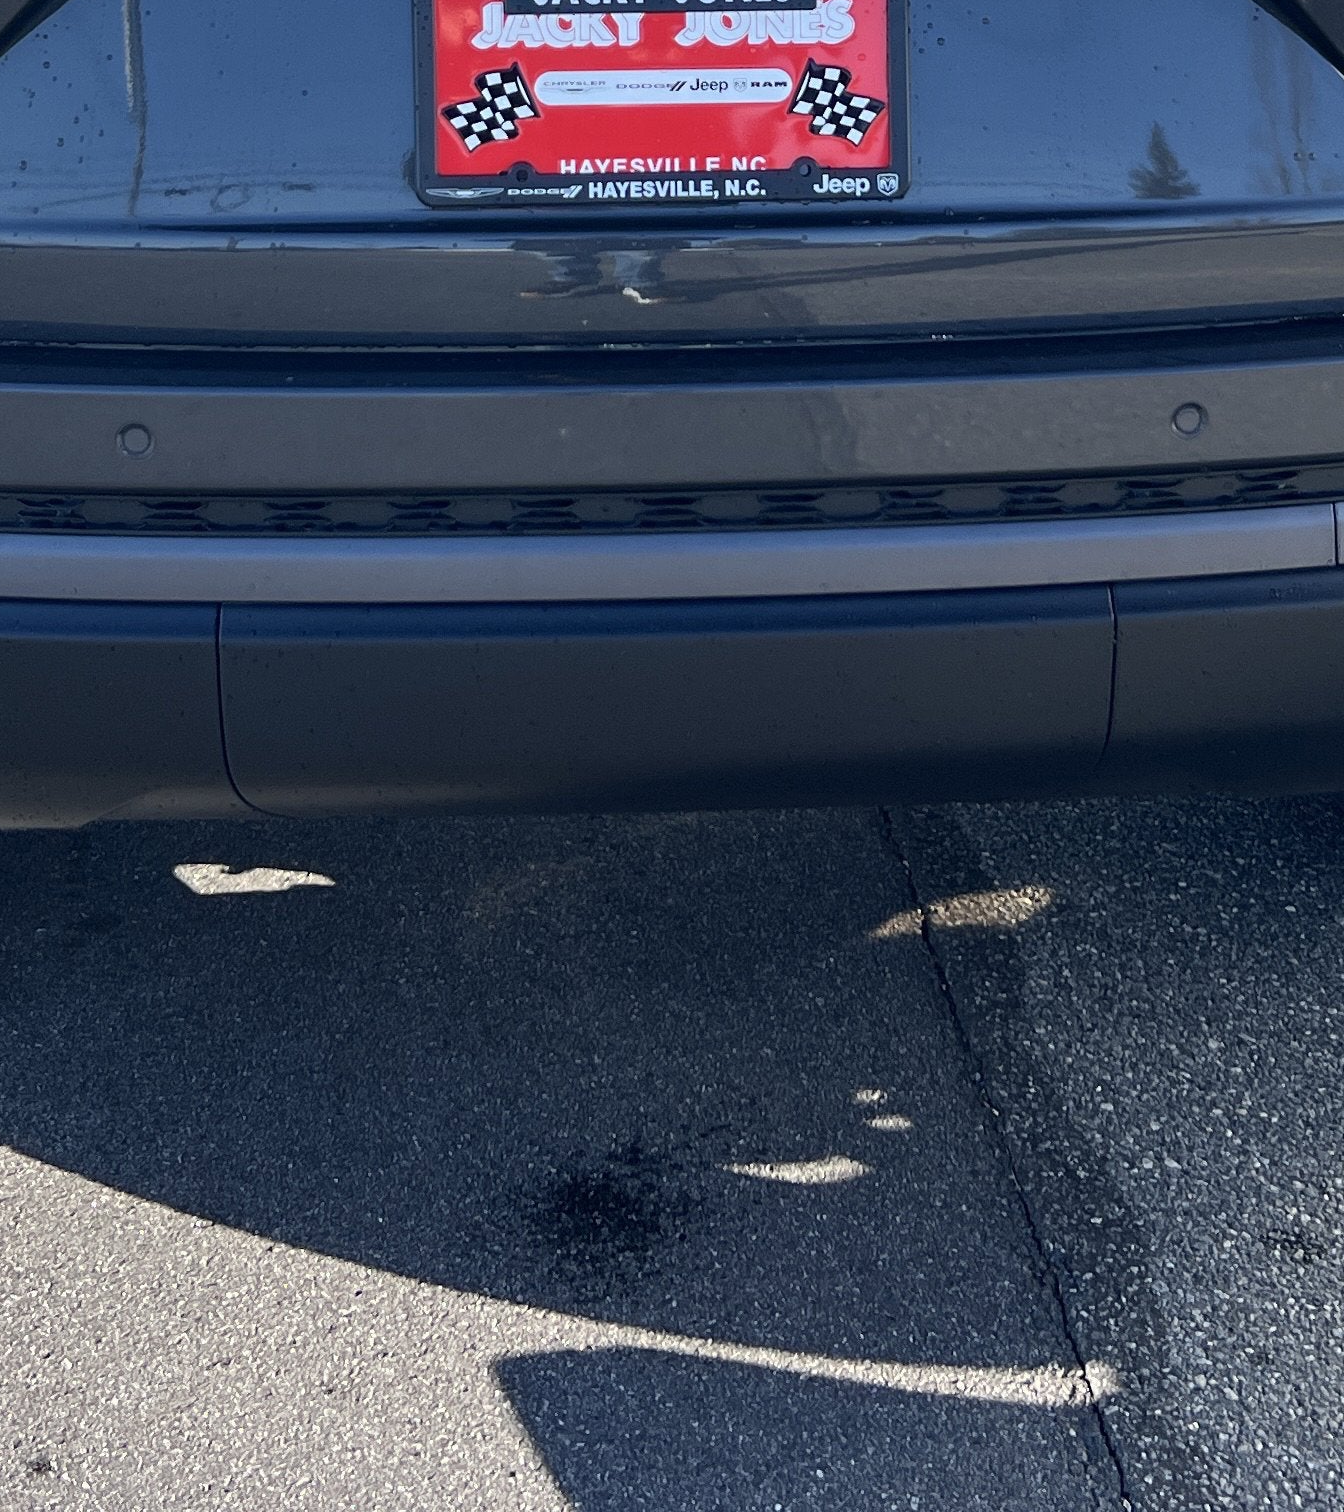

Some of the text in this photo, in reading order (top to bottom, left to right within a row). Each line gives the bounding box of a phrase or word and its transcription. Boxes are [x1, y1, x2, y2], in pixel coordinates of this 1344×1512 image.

[470, 0, 646, 48] JACKY
[689, 78, 729, 93] Jeep
[588, 179, 720, 199] HAYESVILLE,
[725, 178, 767, 196] N.C.
[813, 173, 871, 197] Jeep
